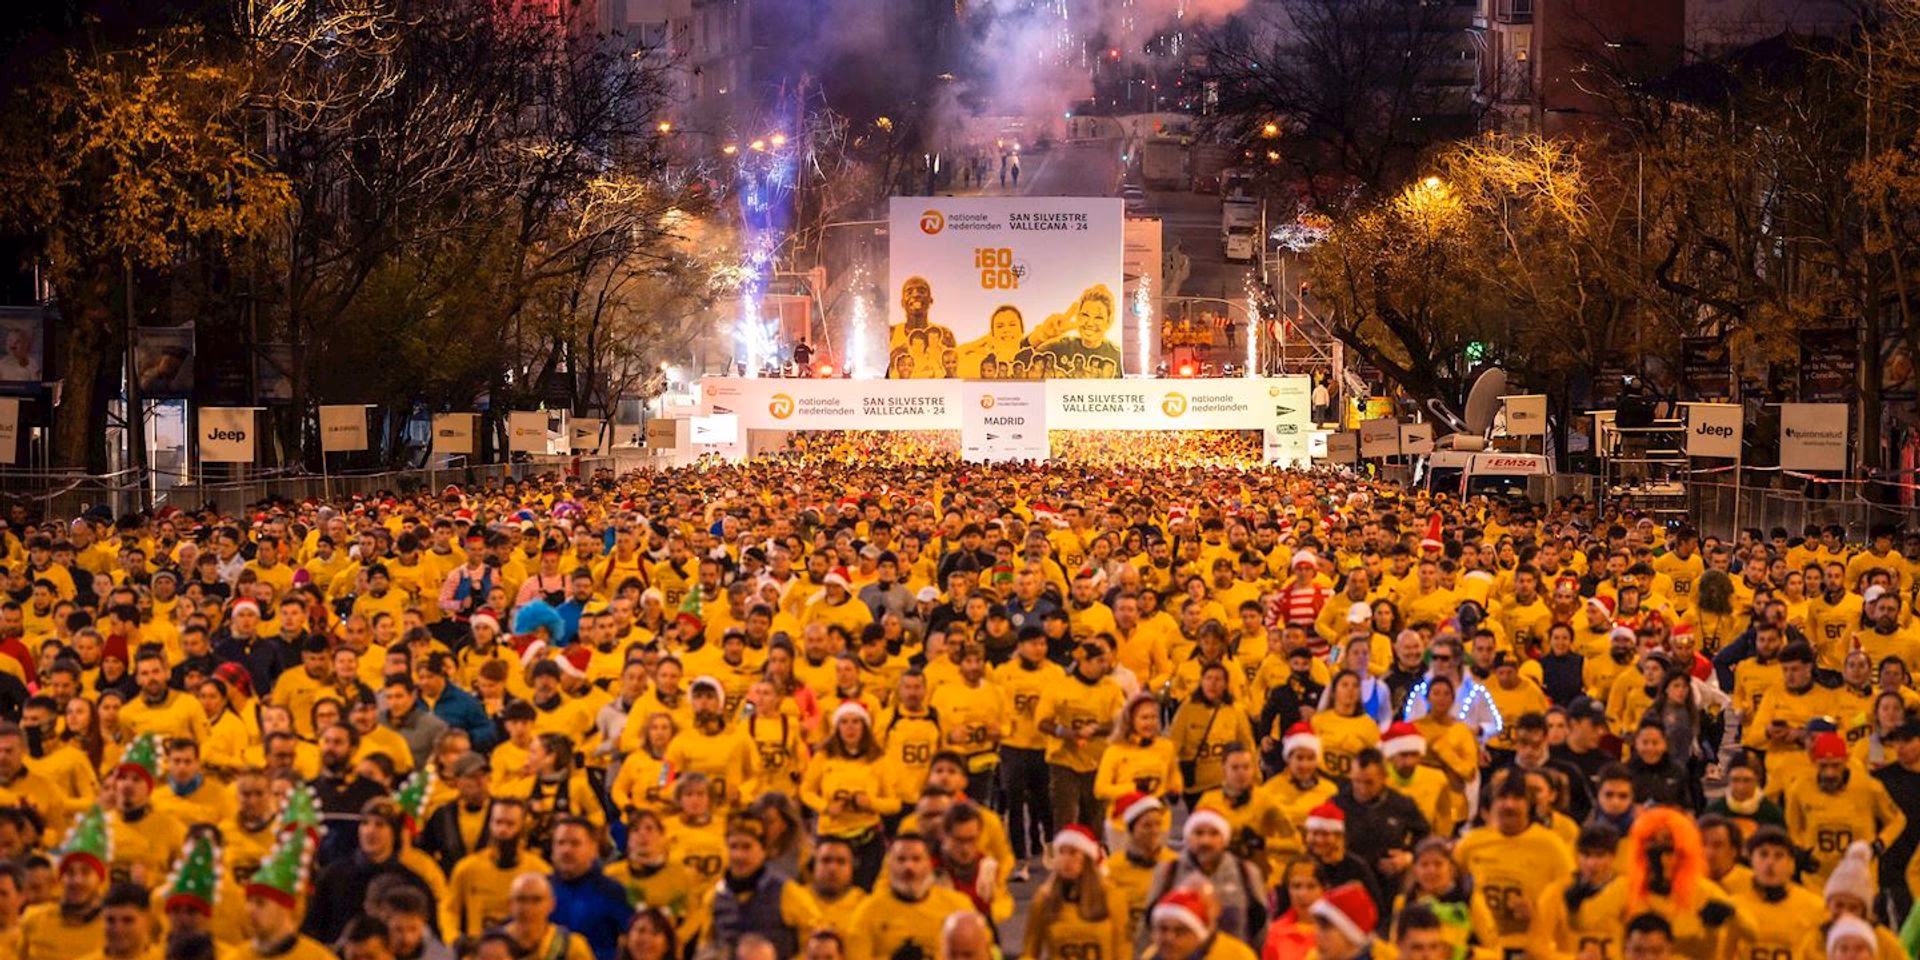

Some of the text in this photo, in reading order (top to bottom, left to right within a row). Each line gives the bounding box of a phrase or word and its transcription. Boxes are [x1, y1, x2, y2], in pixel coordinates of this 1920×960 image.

[949, 213, 988, 221] nationale
[1009, 213, 1088, 221] SAN SILVESTRE
[949, 222, 1001, 230] nederlanden
[1009, 222, 1088, 231] VALLECANA 24
[799, 397, 840, 406] nationale
[863, 397, 945, 406] SAN SILVESTRE
[1062, 394, 1145, 403] SAN SILVESTRE
[1191, 394, 1234, 403] nationale
[799, 406, 855, 415] nederlanden
[863, 406, 946, 415] VALLECANA 24
[1062, 403, 1146, 412] VALLECANA 24
[1191, 403, 1248, 412] nederlanden
[984, 417, 1025, 425] MADRID
[208, 427, 246, 443] Jeep
[1696, 422, 1733, 439] Jeep
[1067, 554, 1083, 567] 60
[1674, 580, 1691, 593] 60
[902, 743, 930, 764] 60
[1323, 751, 1351, 774] 60
[1818, 830, 1852, 853] 60
